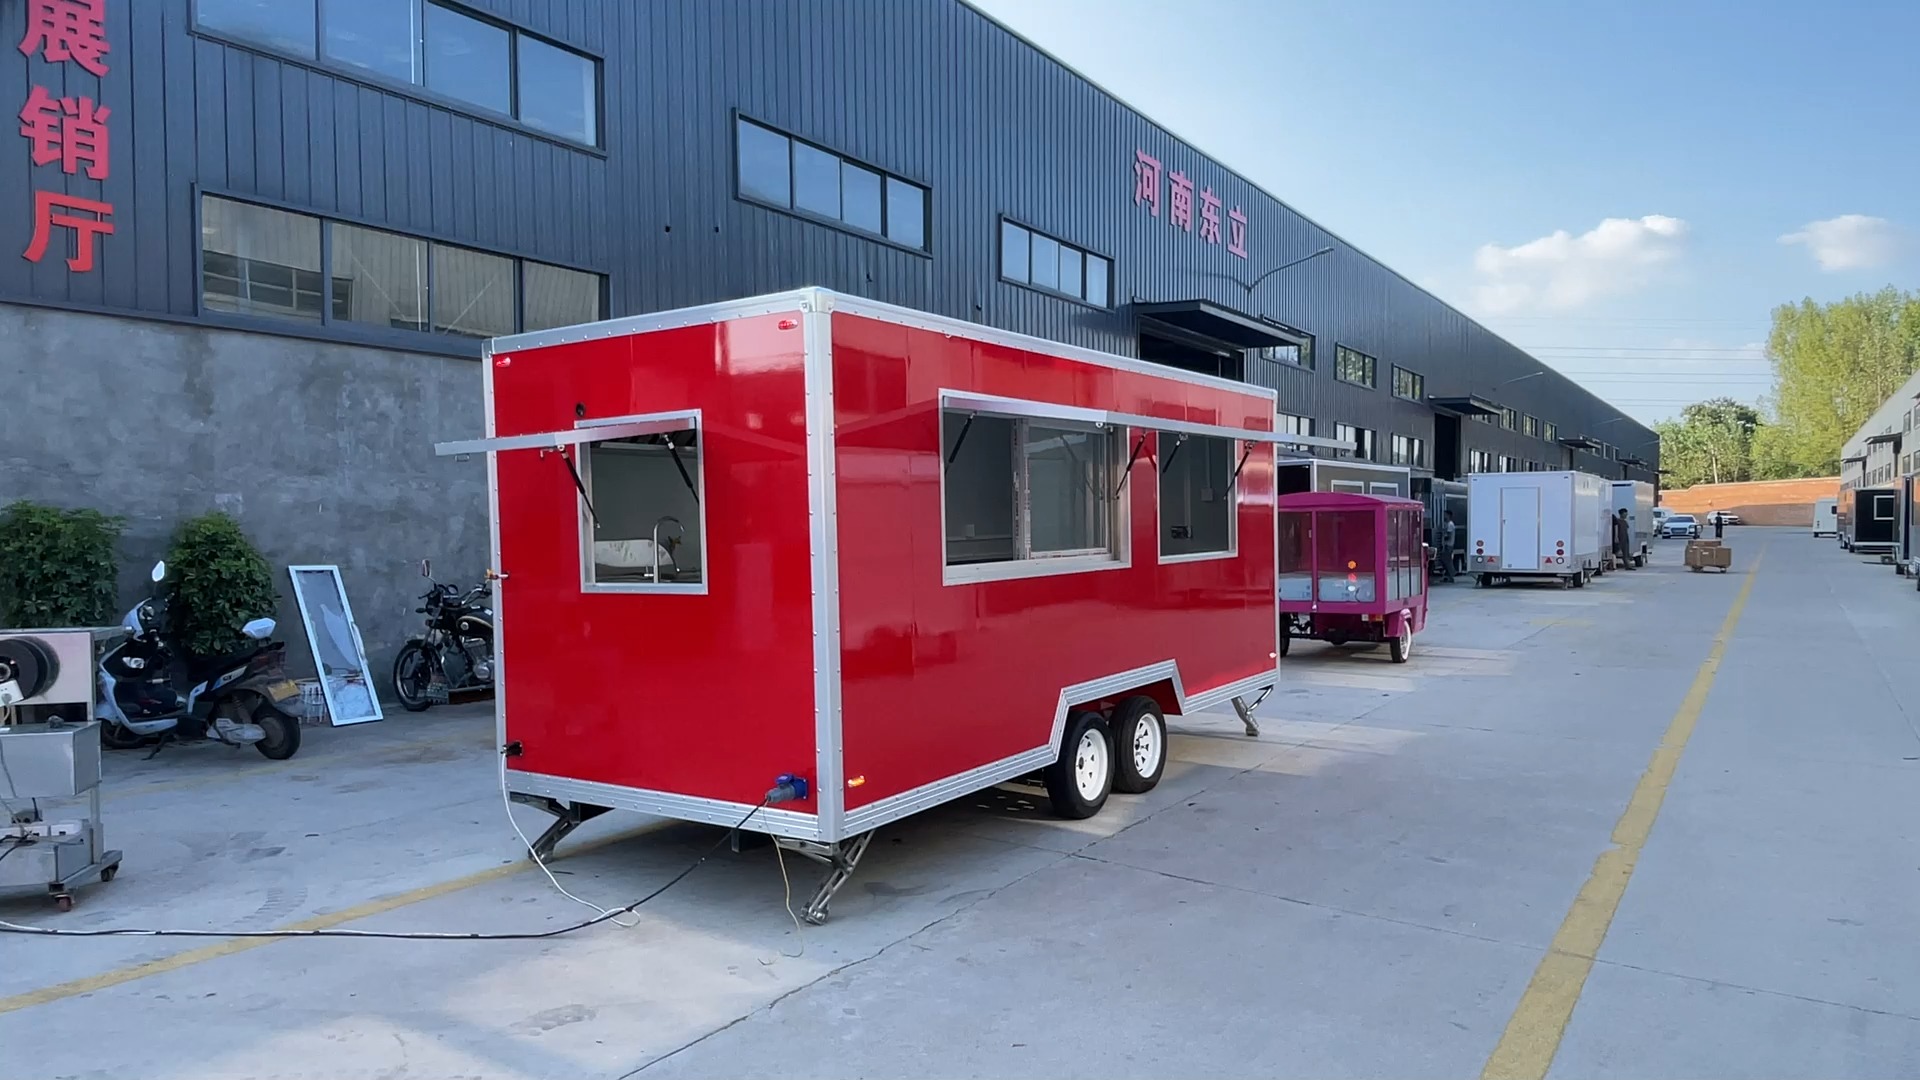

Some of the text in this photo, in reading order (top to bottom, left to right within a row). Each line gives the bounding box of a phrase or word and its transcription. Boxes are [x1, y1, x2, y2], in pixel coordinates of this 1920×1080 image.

[18, 0, 114, 271] 展销厅
[1133, 148, 1248, 259] 河南东立
